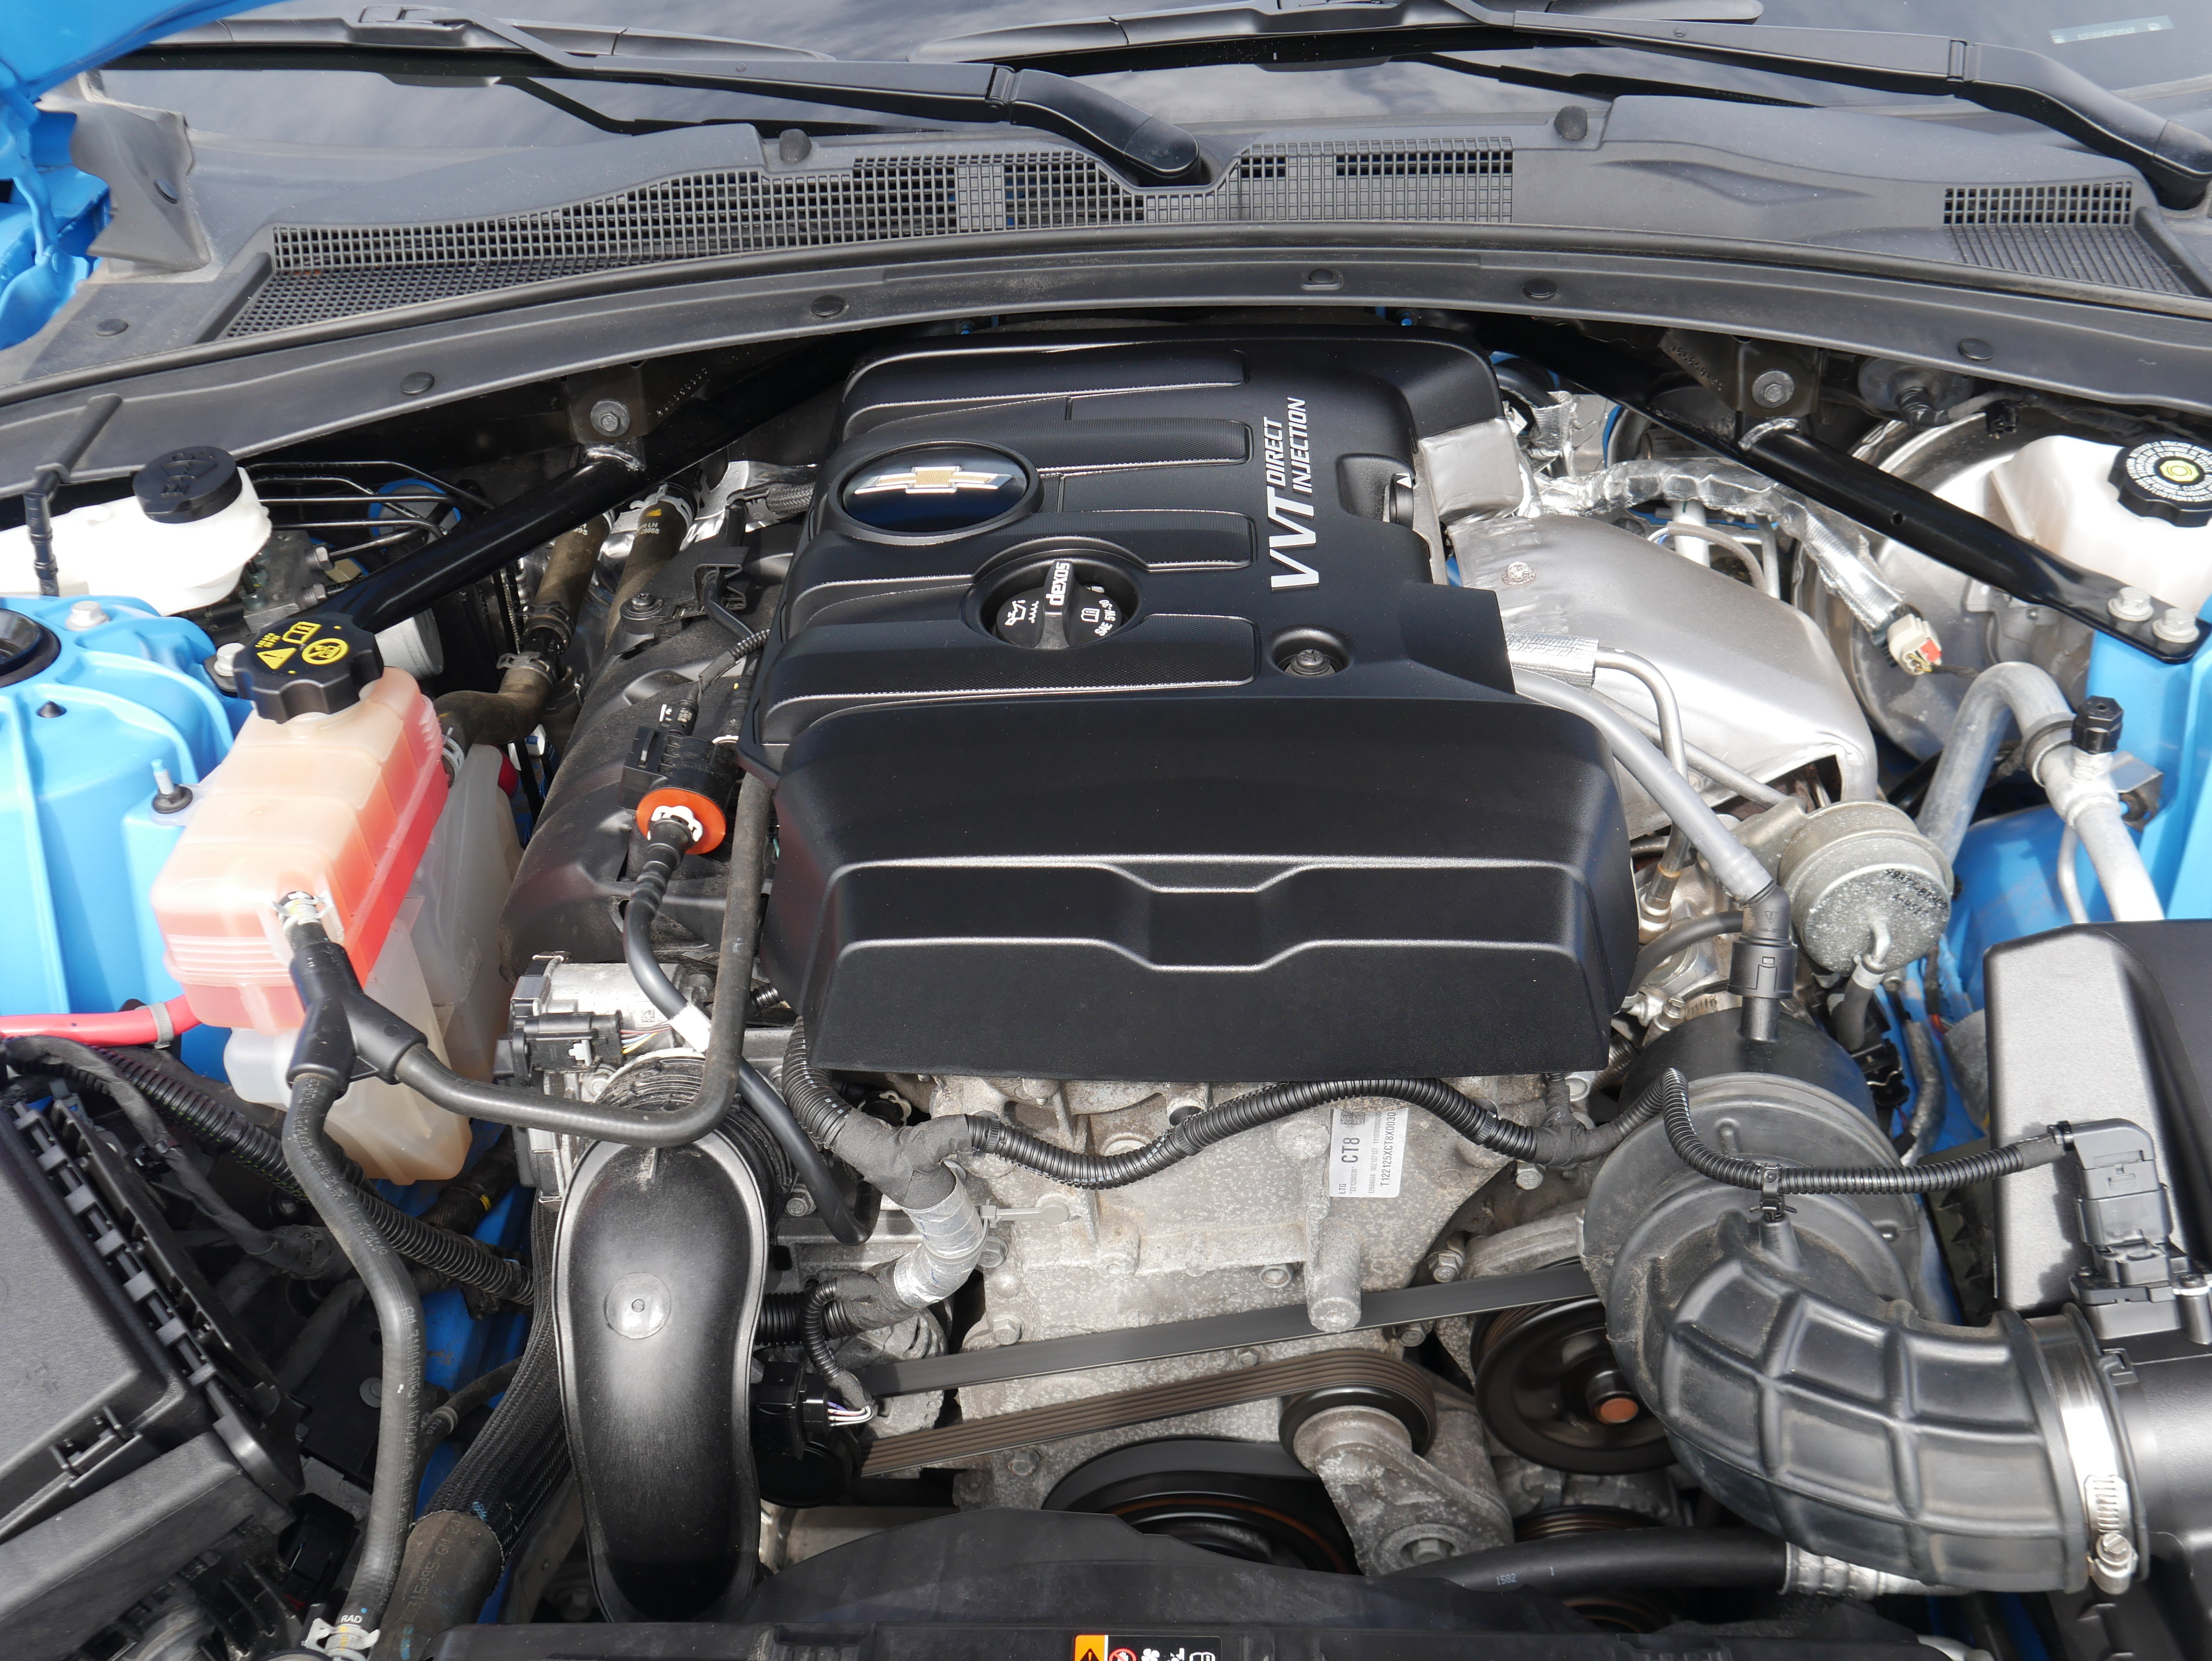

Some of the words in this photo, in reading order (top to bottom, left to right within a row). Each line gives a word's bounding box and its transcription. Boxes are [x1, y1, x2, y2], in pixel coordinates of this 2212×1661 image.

[1263, 416, 1286, 487] DIRECT
[1287, 397, 1312, 494] INJECTION
[1266, 486, 1319, 589] VVT
[1045, 561, 1070, 606] dexos
[1099, 599, 1116, 622] 5W-30
[1094, 621, 1113, 637] SAE
[1341, 1137, 1360, 1163] CT8
[1380, 1112, 1396, 1186] T122125XCT8X0030
[1338, 1183, 1347, 1194] LTG
[1496, 1573, 1517, 1586] 1582
[340, 1614, 363, 1623] RAD
